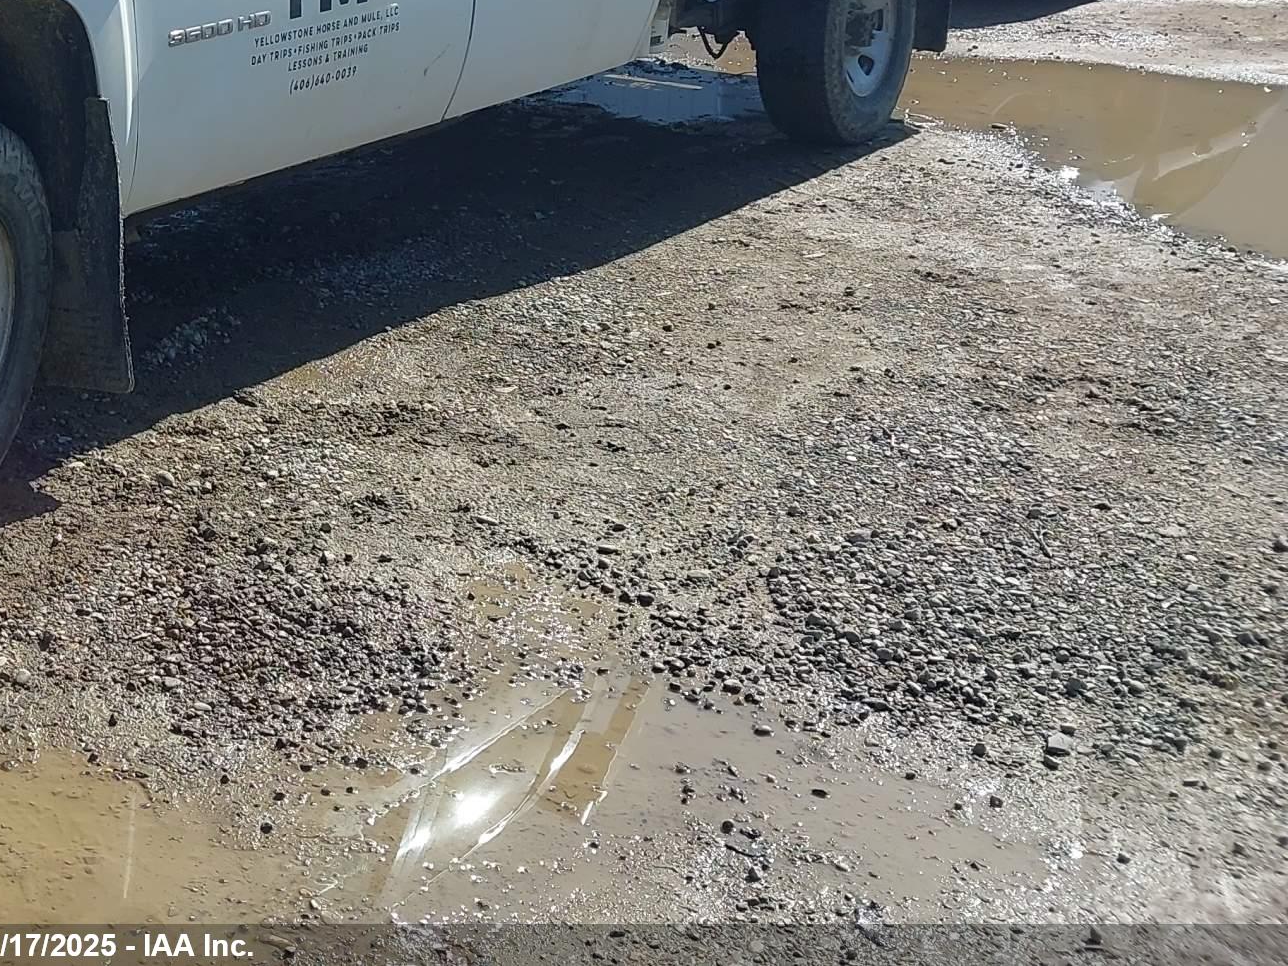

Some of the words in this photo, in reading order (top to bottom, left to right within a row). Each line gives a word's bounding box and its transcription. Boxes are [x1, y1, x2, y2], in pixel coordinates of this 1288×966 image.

[237, 10, 271, 32] HD
[254, 29, 314, 48] YELLOWSTONE
[316, 20, 341, 34] HORSE
[343, 16, 359, 27] AND
[362, 11, 384, 23] MULE,
[385, 6, 399, 18] LLC
[251, 53, 266, 66] DAY
[379, 22, 400, 34] TRIPS
[287, 56, 322, 72] LESSONS
[324, 53, 330, 63] &
[333, 43, 368, 61] TRAINING
[289, 65, 357, 94] (406)640-0039
